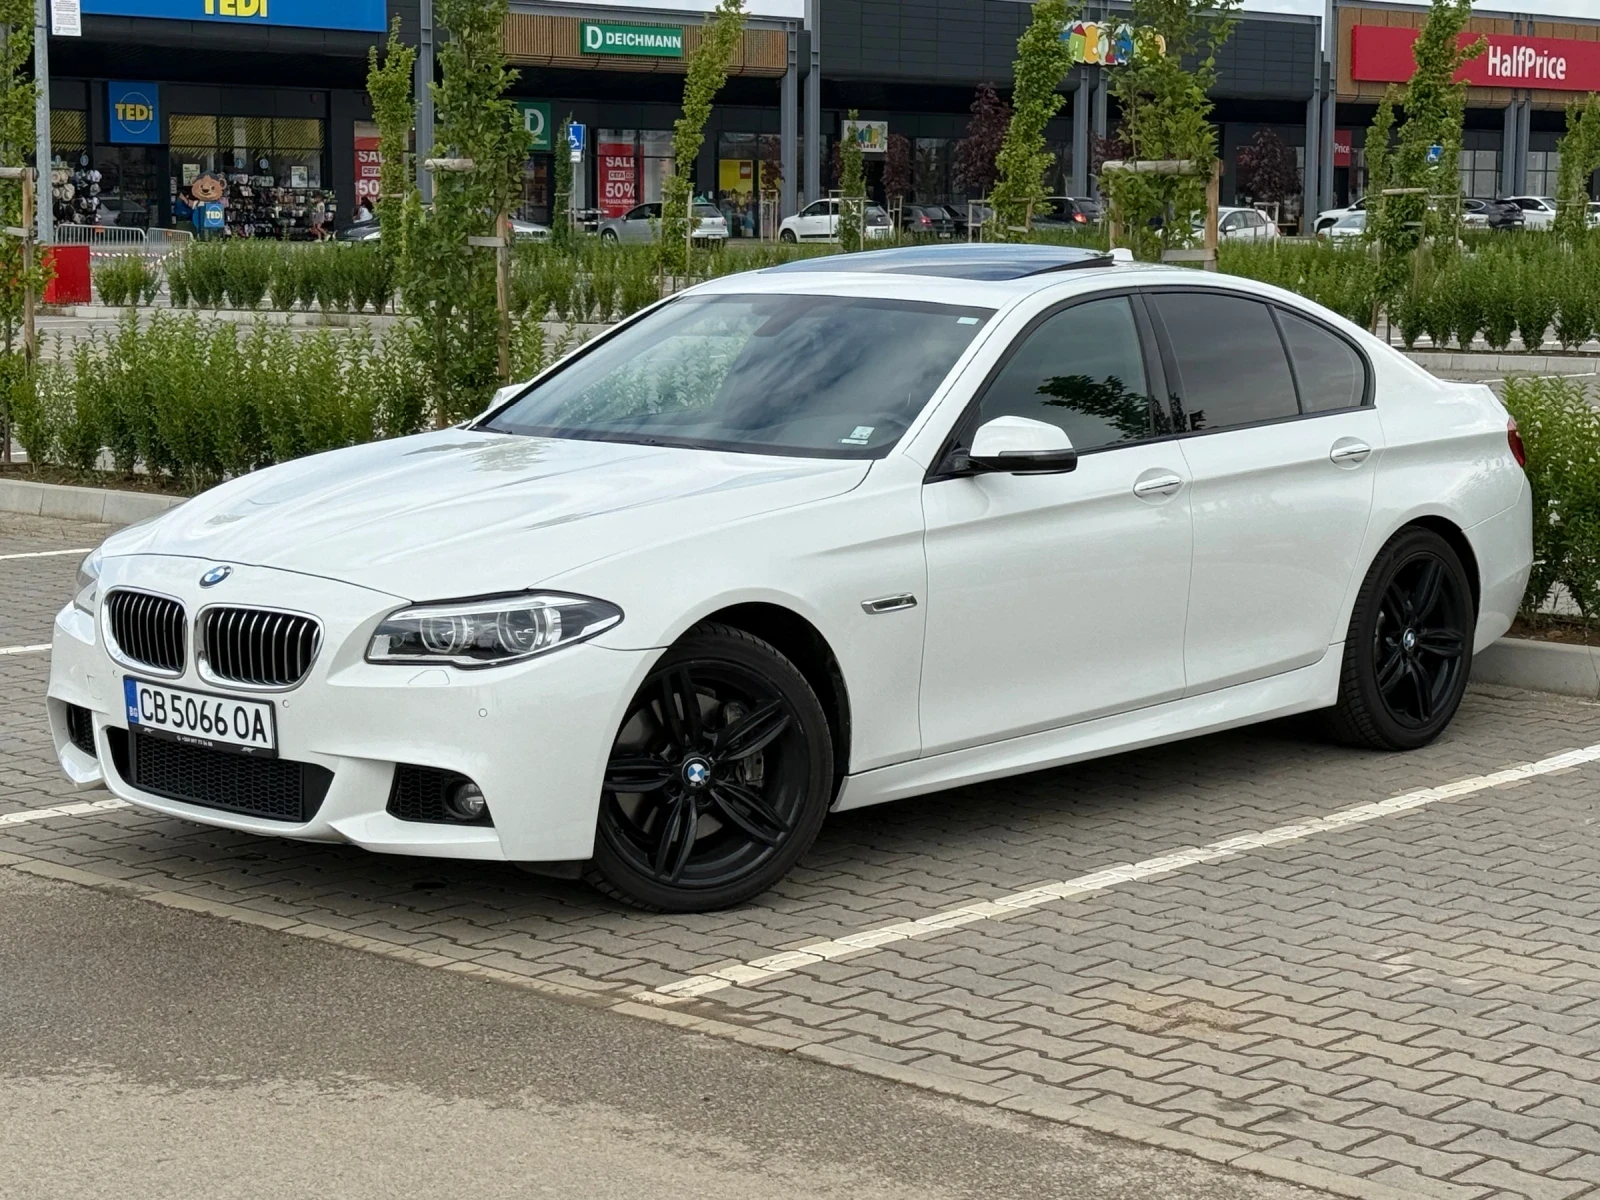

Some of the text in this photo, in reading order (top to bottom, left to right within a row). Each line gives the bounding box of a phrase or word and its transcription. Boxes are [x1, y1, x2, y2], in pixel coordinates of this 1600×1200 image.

[587, 25, 682, 50] D DEICHMANN
[1487, 45, 1567, 80] HalfPrice
[115, 103, 153, 121] TEDi
[524, 108, 545, 137] D
[358, 151, 386, 163] SAL
[1333, 143, 1350, 154] Price
[358, 179, 380, 195] 50
[205, 211, 223, 219] TEDi
[129, 706, 139, 718] BG
[171, 694, 228, 736] 5066
